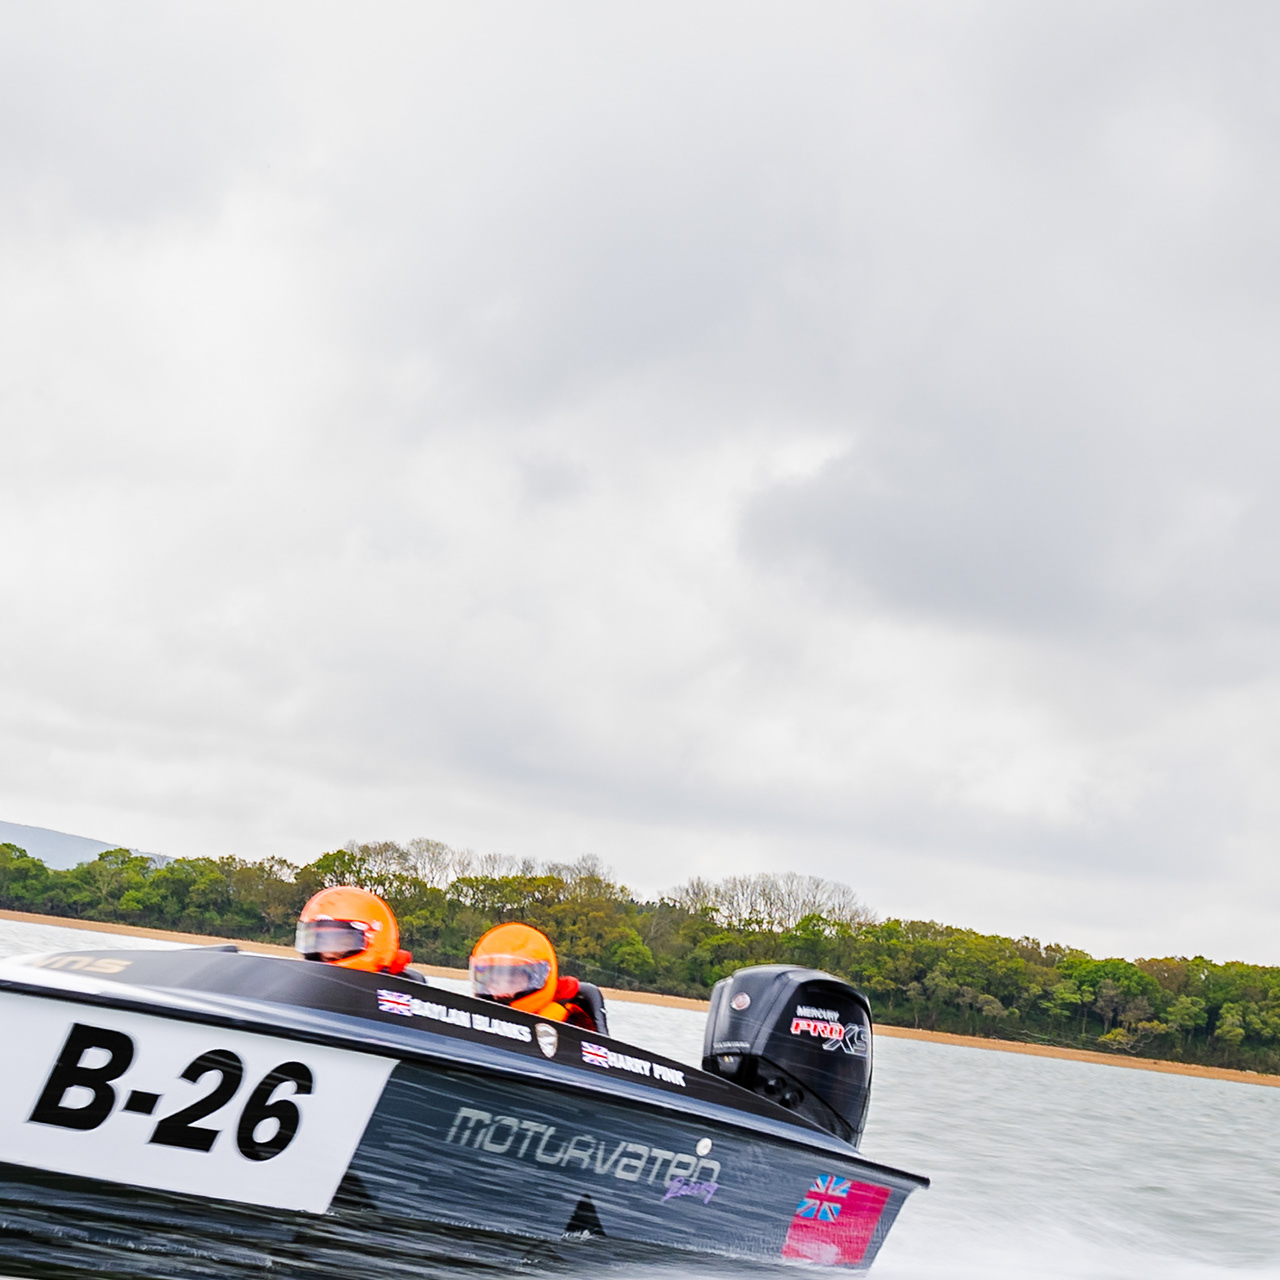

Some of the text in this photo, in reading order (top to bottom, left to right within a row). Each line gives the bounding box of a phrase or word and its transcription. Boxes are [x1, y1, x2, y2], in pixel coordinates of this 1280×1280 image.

[796, 1004, 840, 1022] MERCURY
[789, 1017, 845, 1041] PRO
[27, 1022, 314, 1163] B-26
